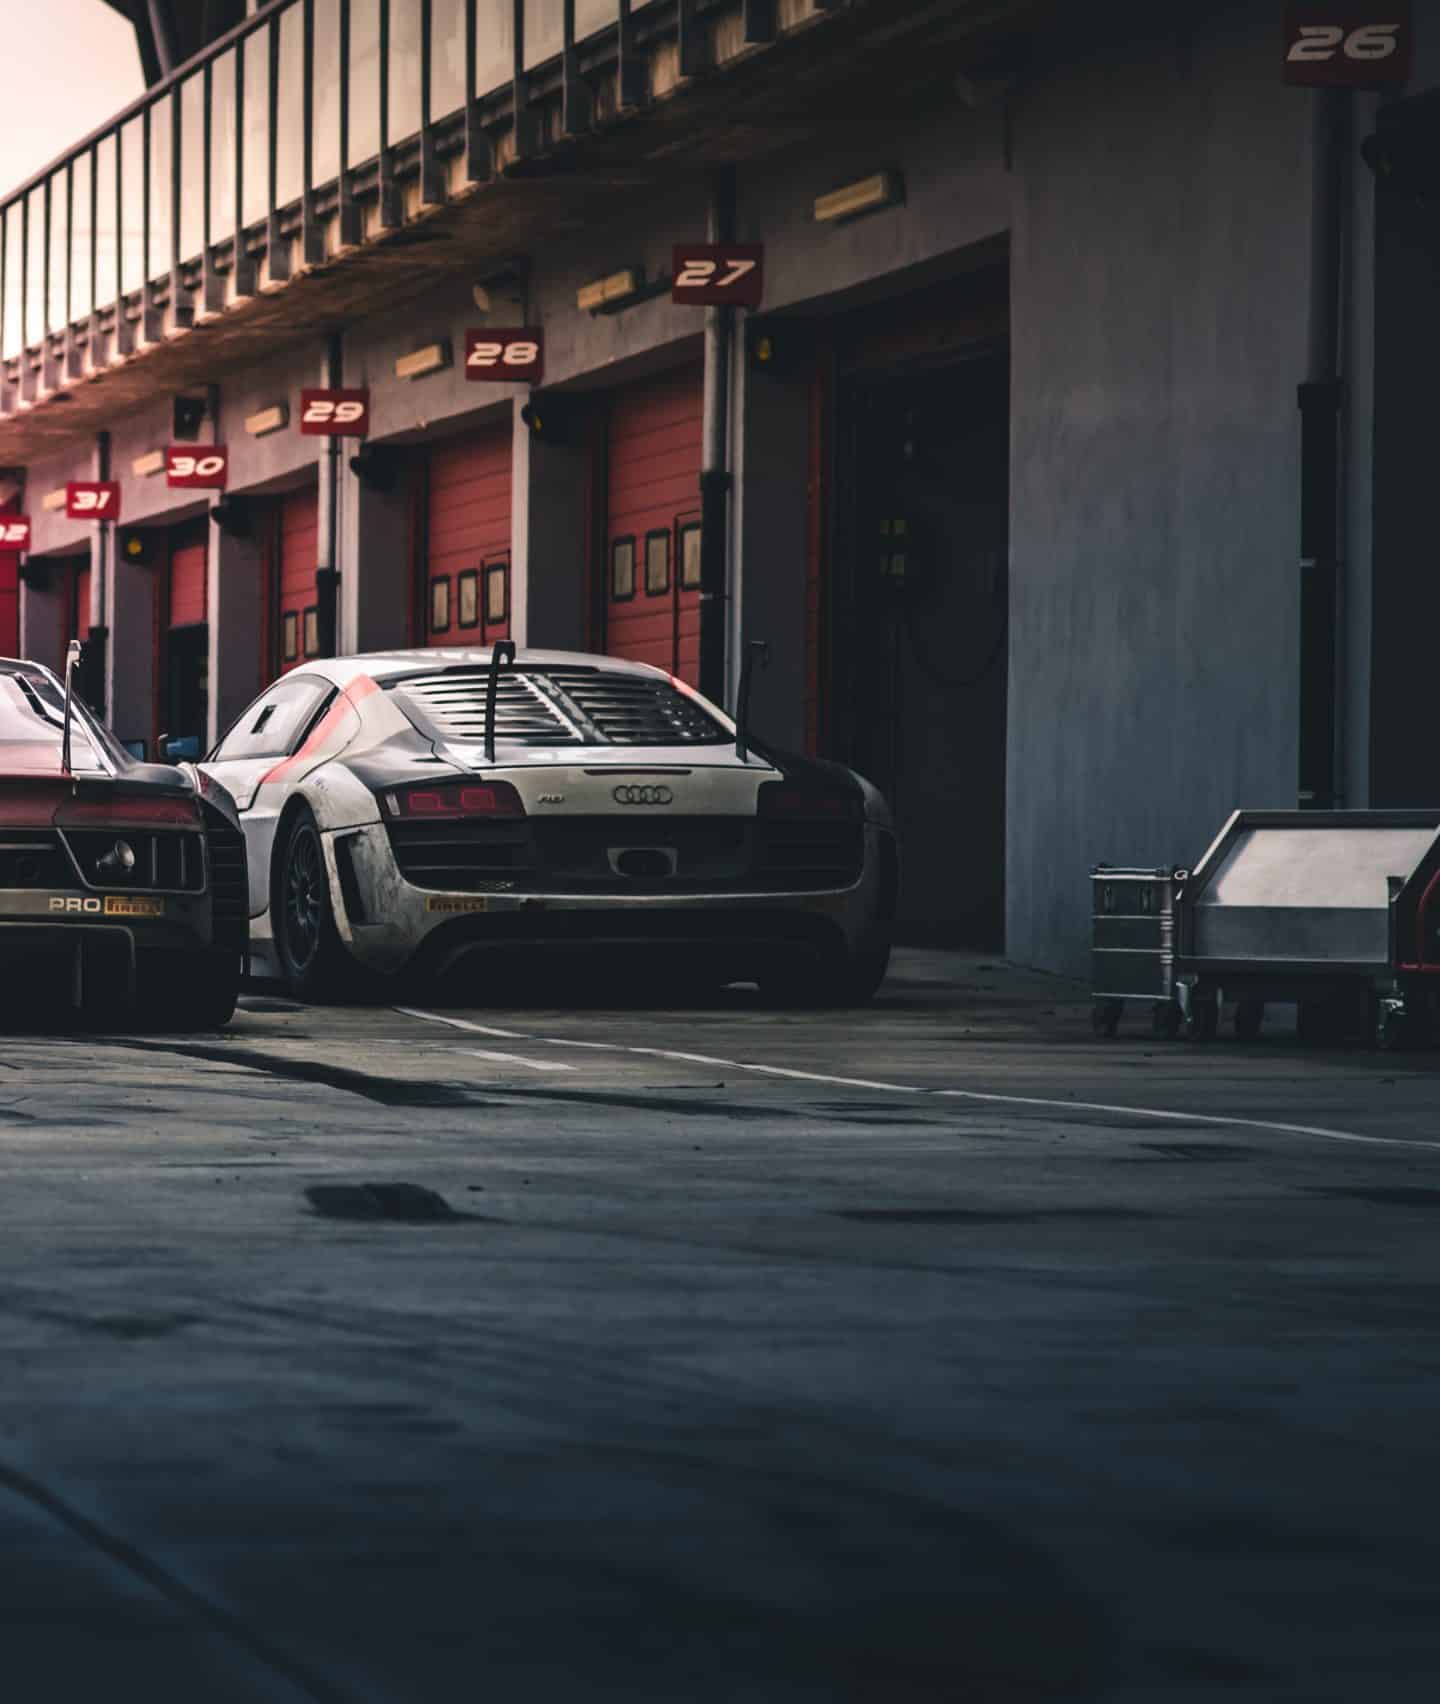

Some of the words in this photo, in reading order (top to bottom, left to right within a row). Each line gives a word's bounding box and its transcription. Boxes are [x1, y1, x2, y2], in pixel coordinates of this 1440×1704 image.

[1286, 24, 1400, 61] 26
[675, 260, 756, 287] 27
[466, 341, 539, 367] 28
[303, 400, 364, 423] 29
[167, 456, 225, 477] 30
[72, 491, 112, 510] 31
[48, 898, 101, 912] PRO
